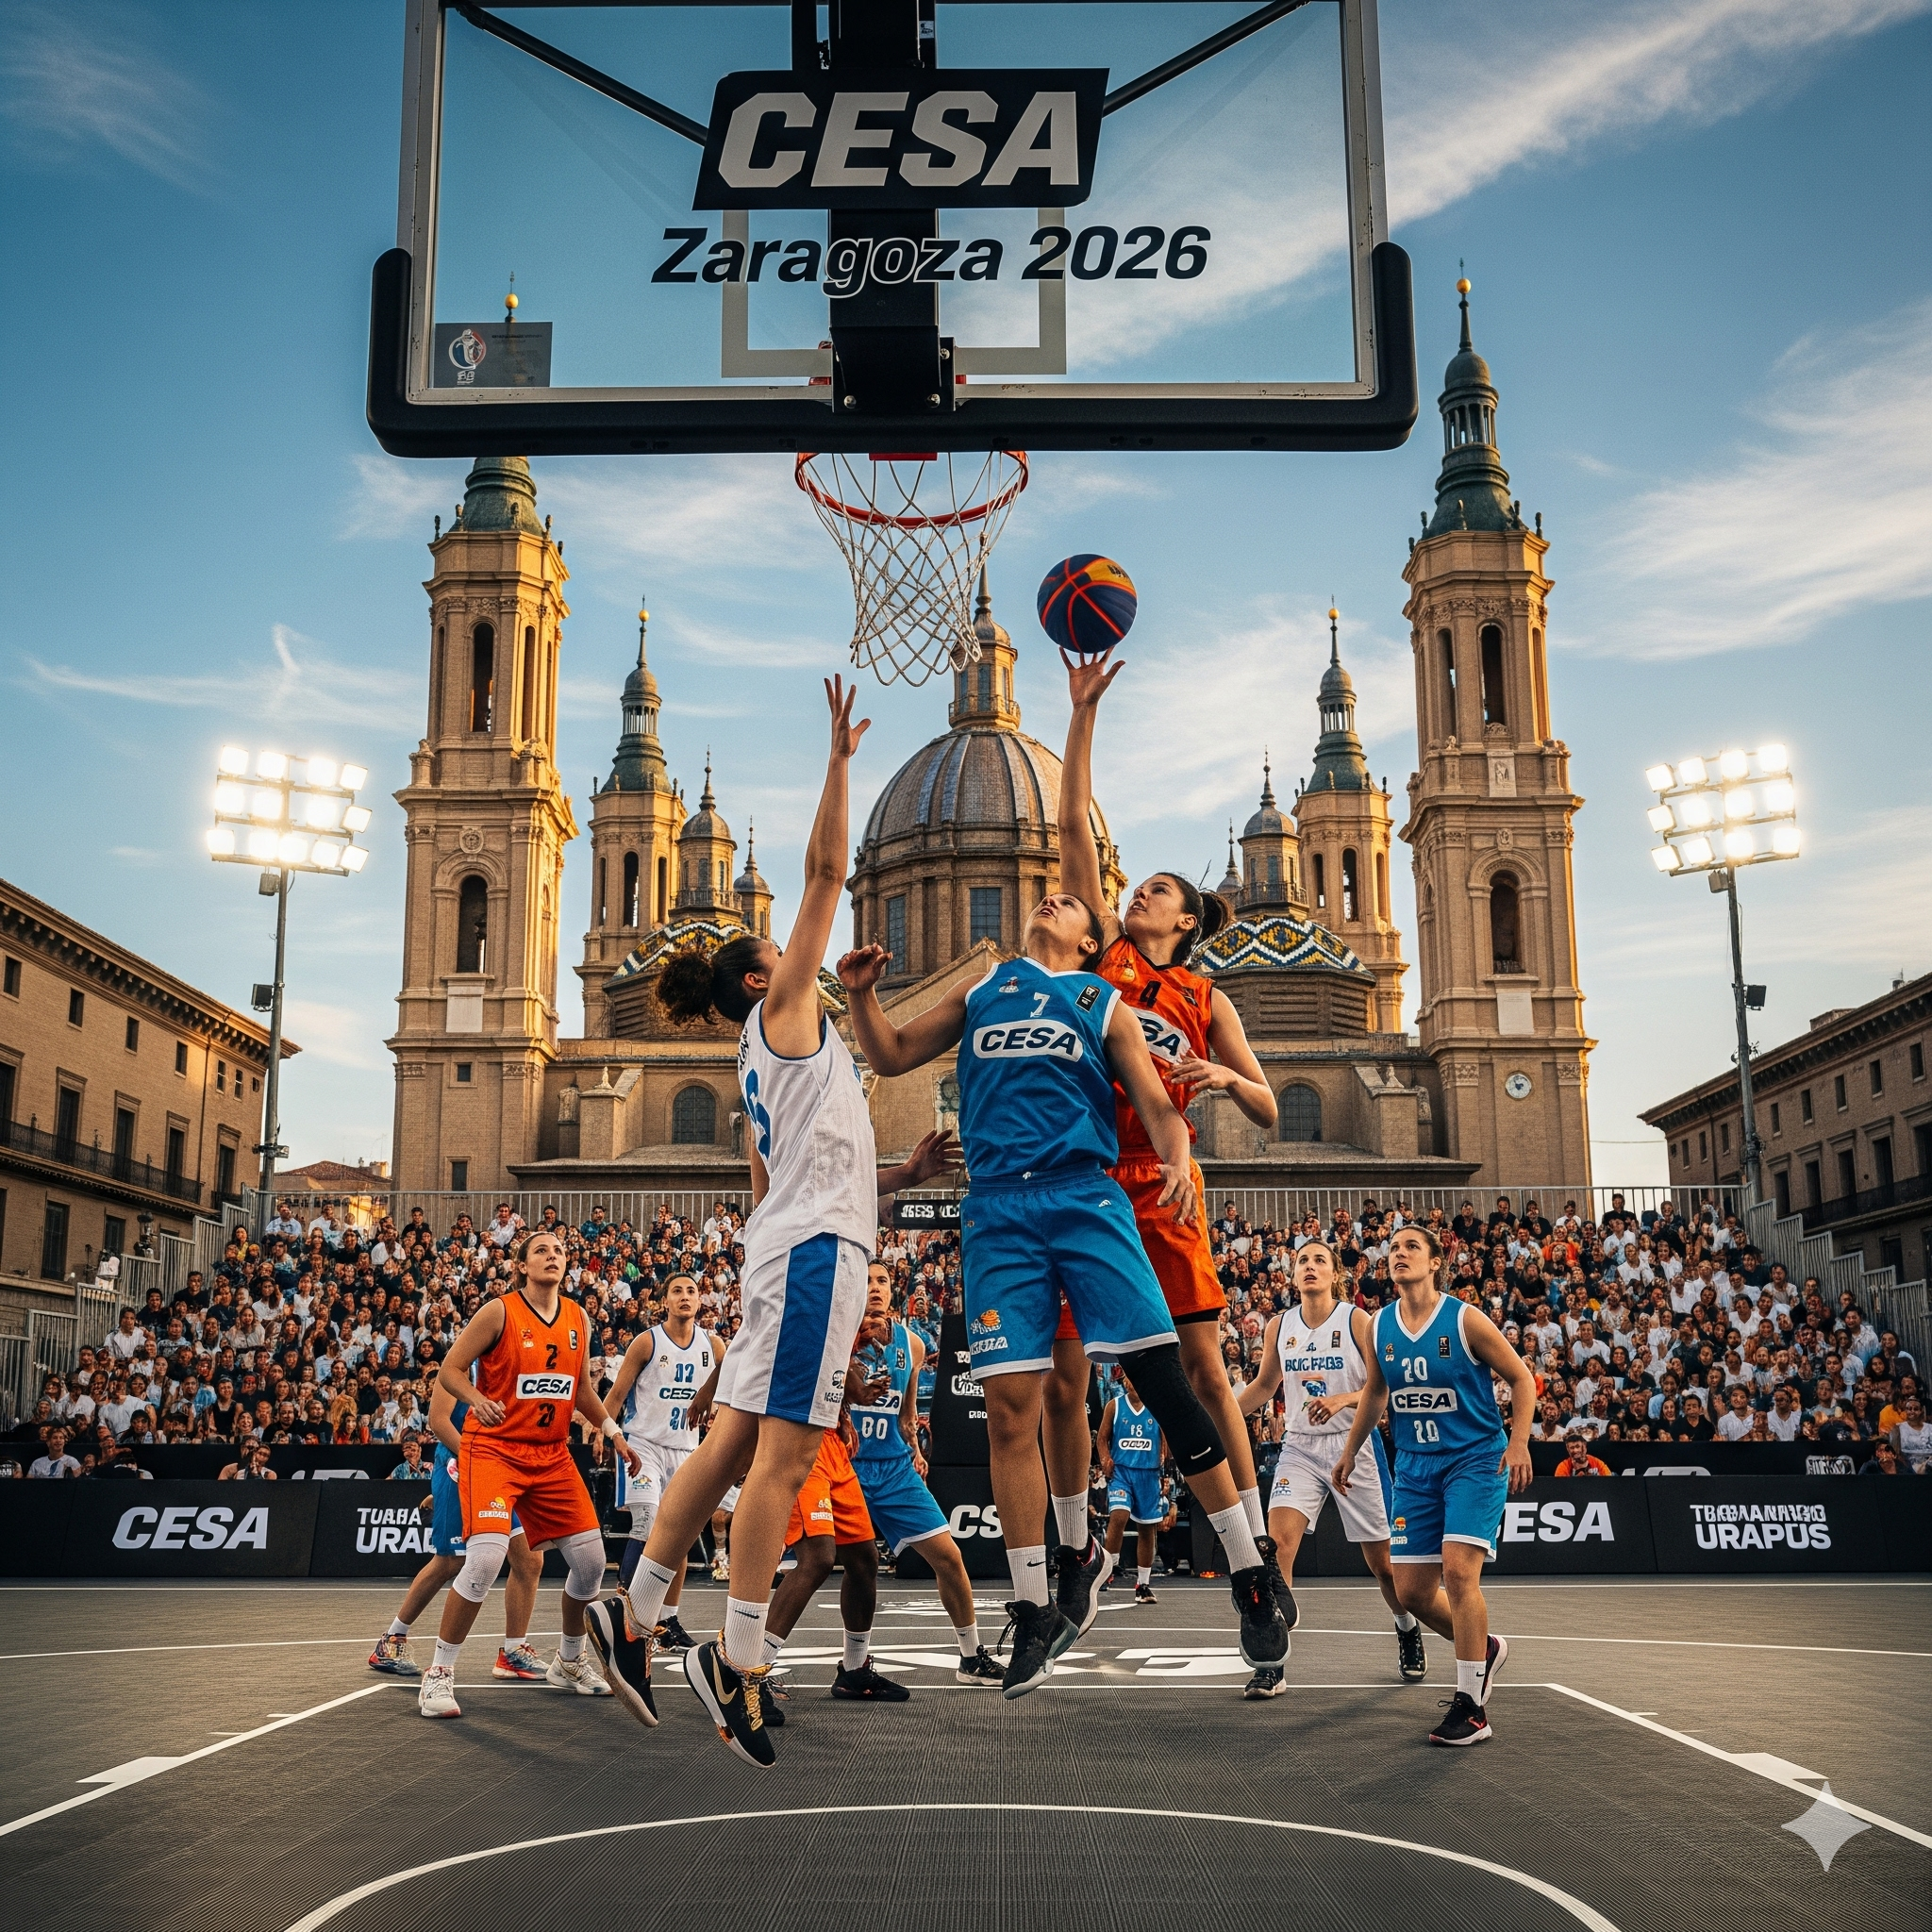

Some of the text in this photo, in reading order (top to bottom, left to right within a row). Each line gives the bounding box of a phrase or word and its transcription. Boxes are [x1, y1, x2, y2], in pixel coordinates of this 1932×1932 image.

[717, 91, 1080, 188] CESA
[651, 225, 1212, 298] Zaragoza 2026
[980, 1026, 1076, 1056] CESA
[1138, 1016, 1181, 1056] SA
[545, 1343, 558, 1370] 2
[1401, 1356, 1428, 1383] 20
[522, 1378, 572, 1395] CESA
[1394, 1392, 1452, 1409] CESA
[111, 1506, 270, 1550] CESA
[1496, 1501, 1615, 1542] ESA
[1694, 1523, 1832, 1550] URAPUS
